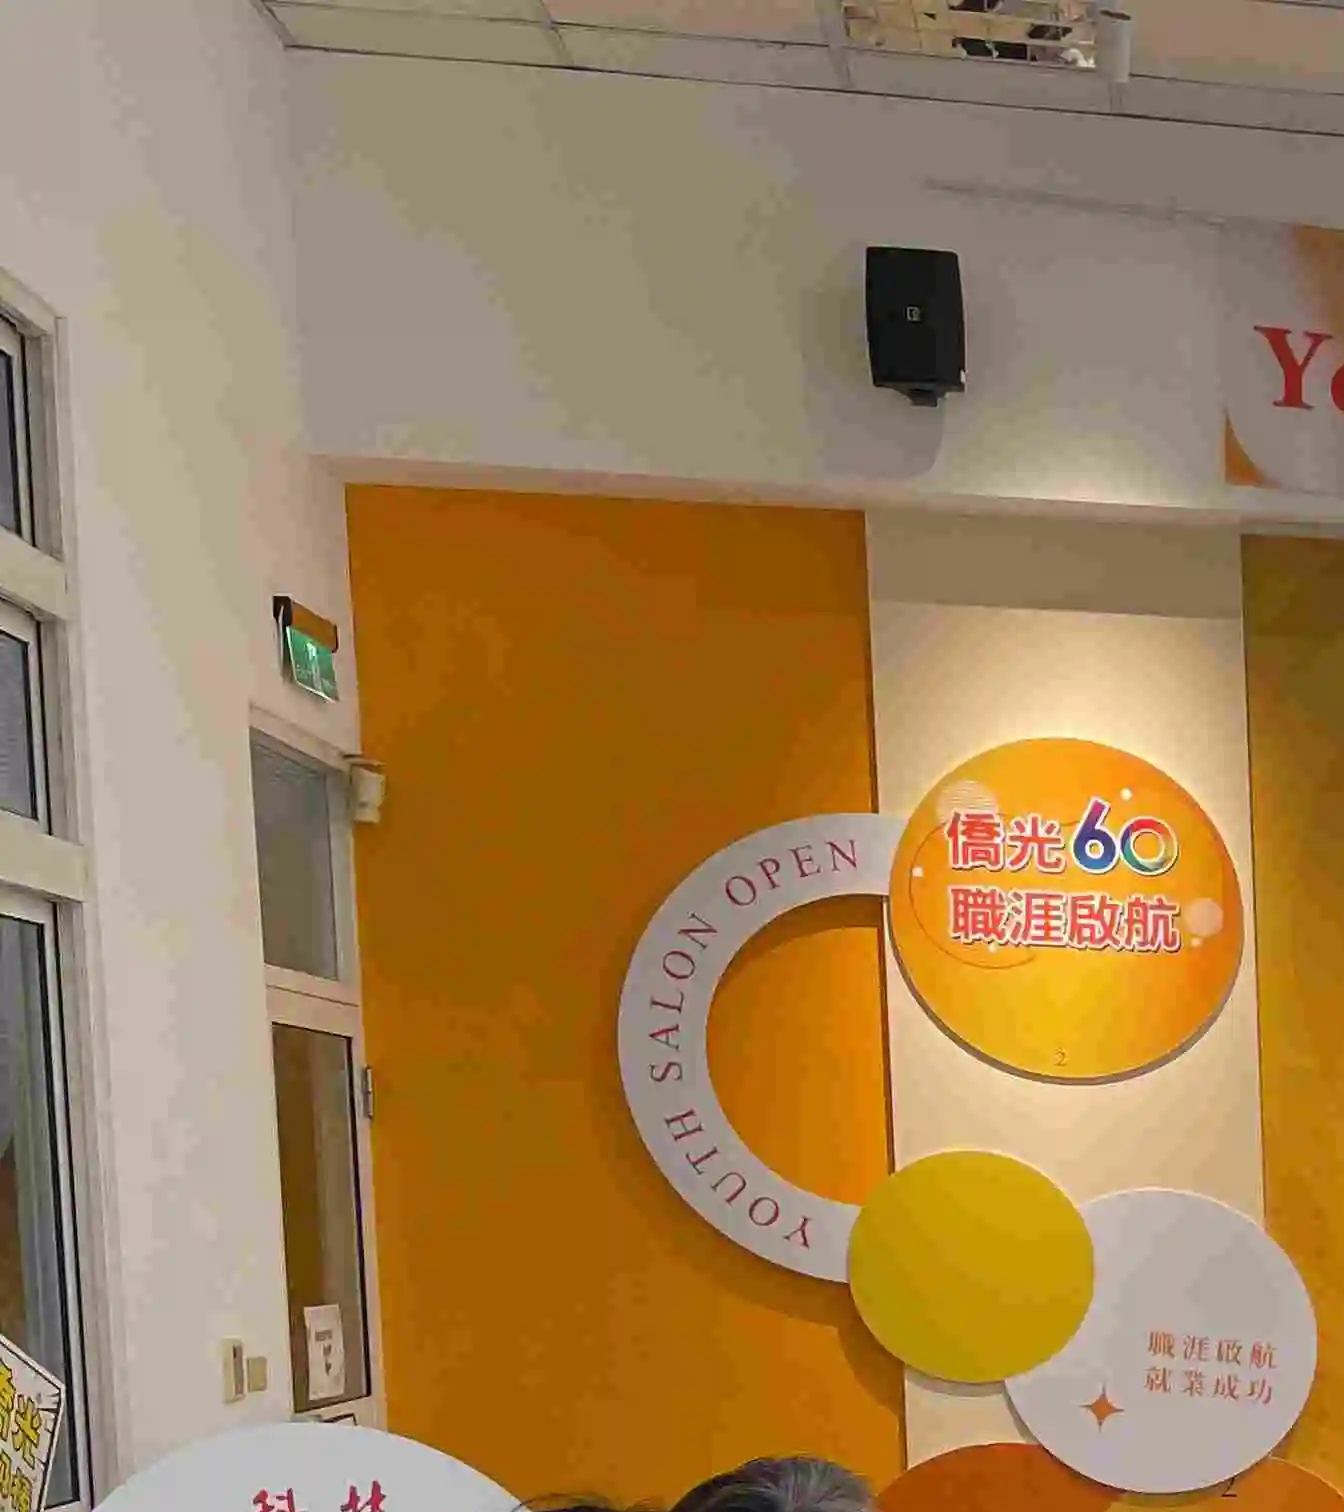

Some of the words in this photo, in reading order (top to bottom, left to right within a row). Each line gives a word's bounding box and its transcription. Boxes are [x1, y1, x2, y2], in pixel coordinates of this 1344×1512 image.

[725, 839, 858, 906] OPEN
[946, 796, 1179, 875] 僑光60
[649, 912, 719, 1083] SALON
[665, 1109, 811, 1250] YOUTH
